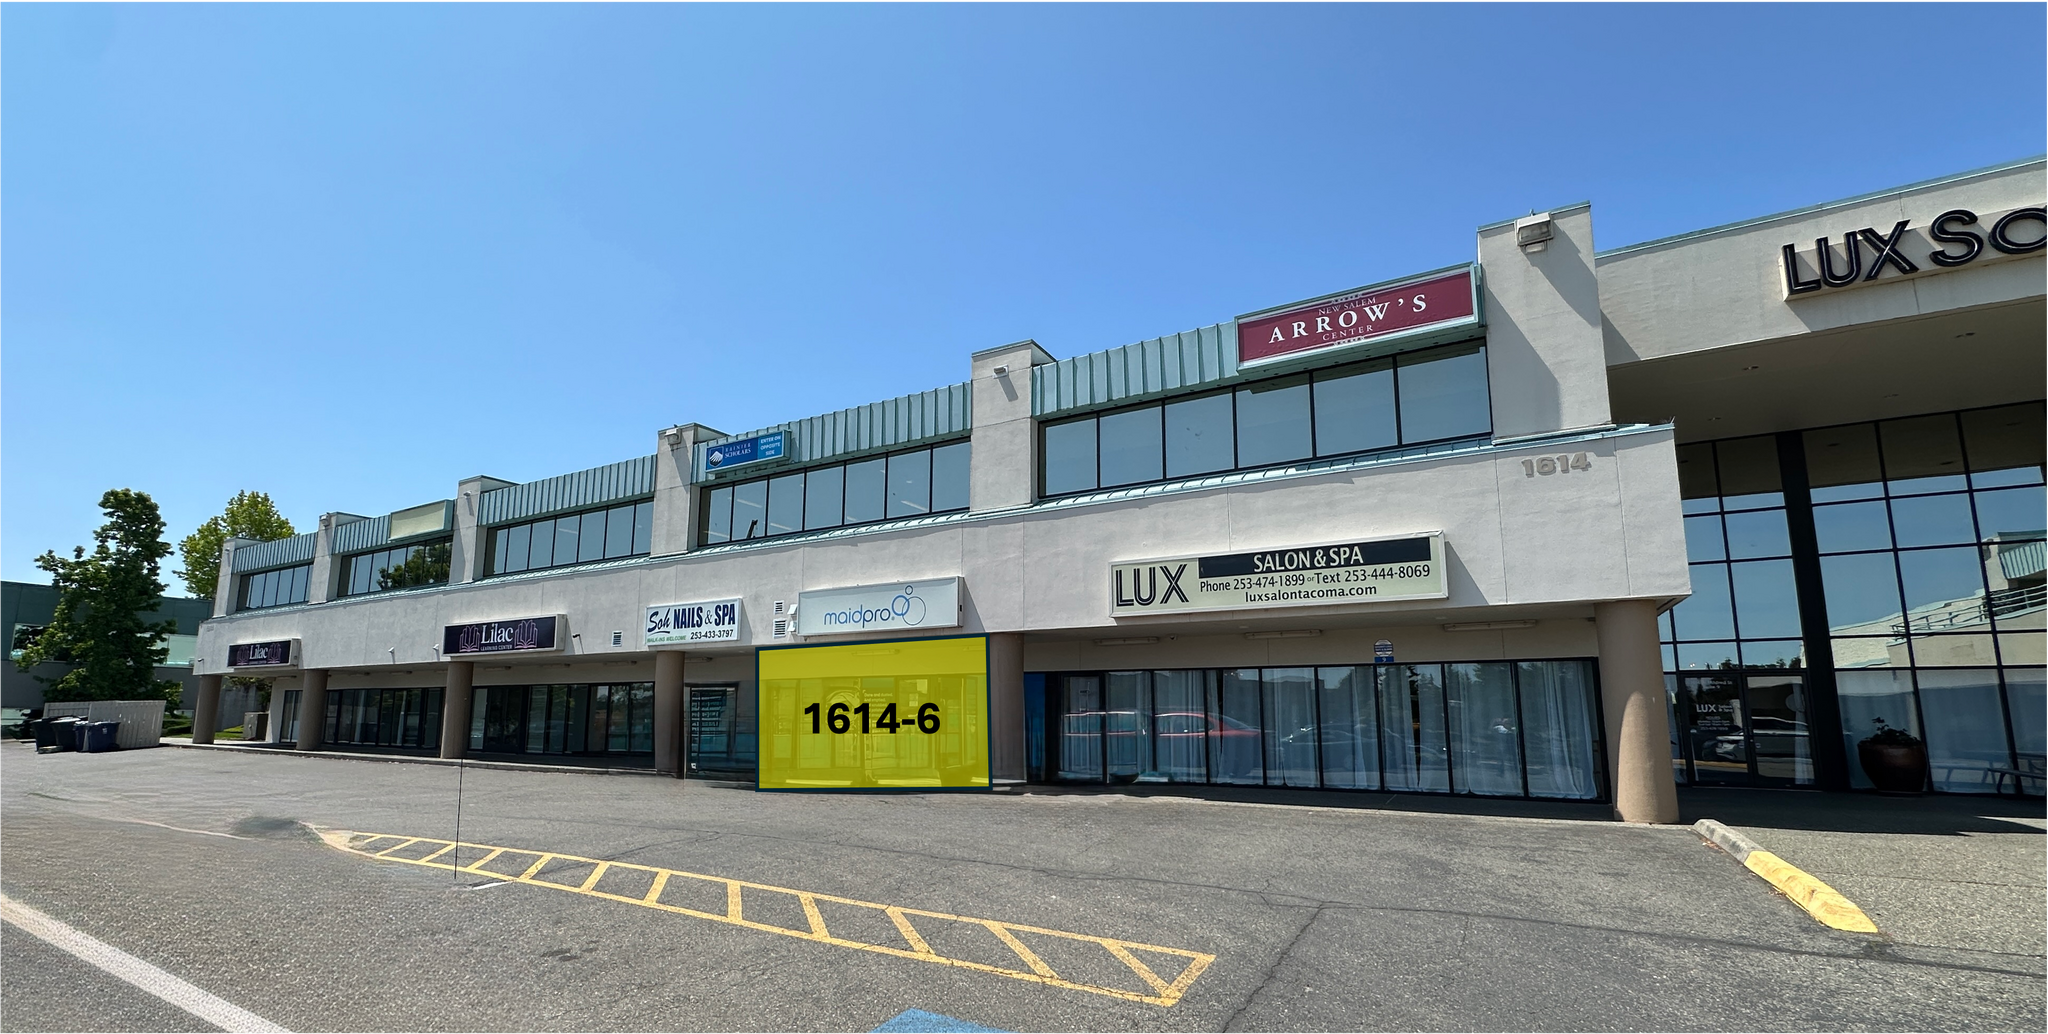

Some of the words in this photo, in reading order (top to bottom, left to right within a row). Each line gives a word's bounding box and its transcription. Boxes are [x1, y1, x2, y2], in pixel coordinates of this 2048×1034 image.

[1782, 219, 1919, 295] LUX
[1318, 304, 1341, 316] NEW
[1343, 297, 1376, 310] SALEM
[1268, 294, 1426, 344] ARROW'S
[1322, 324, 1373, 341] CENTER
[724, 448, 751, 459] SCHOLARS
[1521, 451, 1591, 478] 1614
[1253, 549, 1311, 572] SALON
[1312, 549, 1326, 566] &
[1329, 545, 1363, 565] SPA
[1115, 563, 1189, 607] LUX
[1199, 579, 1231, 593] Phone
[1233, 573, 1305, 590] 253-474-1899
[1314, 571, 1341, 585] Text
[1344, 564, 1431, 582] 253-444-8069
[1245, 585, 1377, 603] luxsalontacoma.com
[647, 608, 671, 633] Soh
[673, 606, 703, 629] NAILS
[705, 610, 713, 625] &
[715, 603, 736, 626] SPA
[824, 604, 891, 628] maidpro
[481, 623, 514, 644] Lilac
[690, 629, 733, 640] 253-433-3797
[249, 644, 268, 660] Lilac
[1696, 704, 1717, 713] LUX
